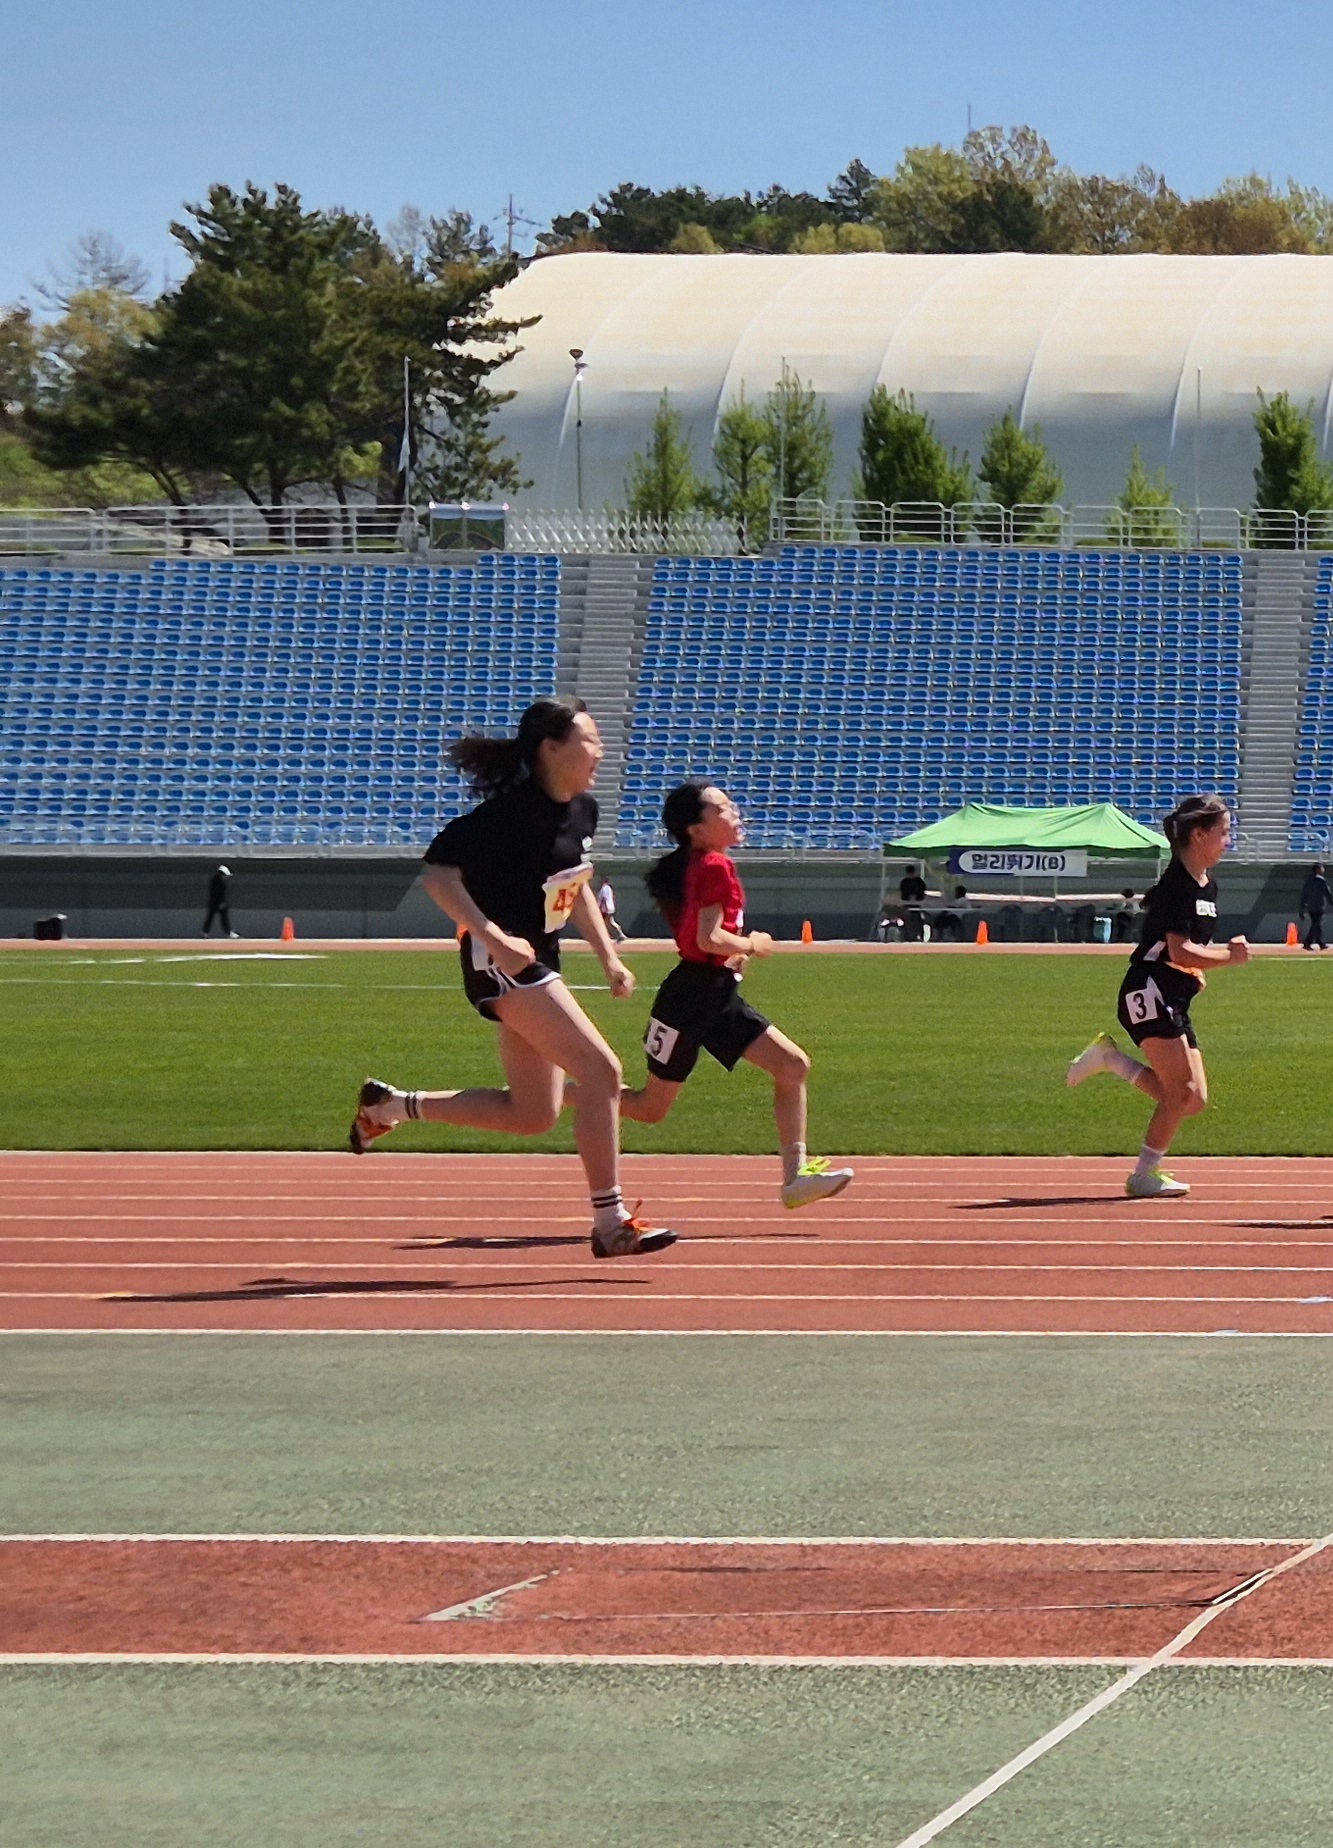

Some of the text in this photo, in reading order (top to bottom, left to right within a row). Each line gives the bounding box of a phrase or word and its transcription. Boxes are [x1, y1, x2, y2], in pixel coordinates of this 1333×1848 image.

[971, 853, 1066, 872] 멀리뛰기(B)
[1133, 992, 1147, 1020] 3
[650, 1025, 667, 1057] 5
